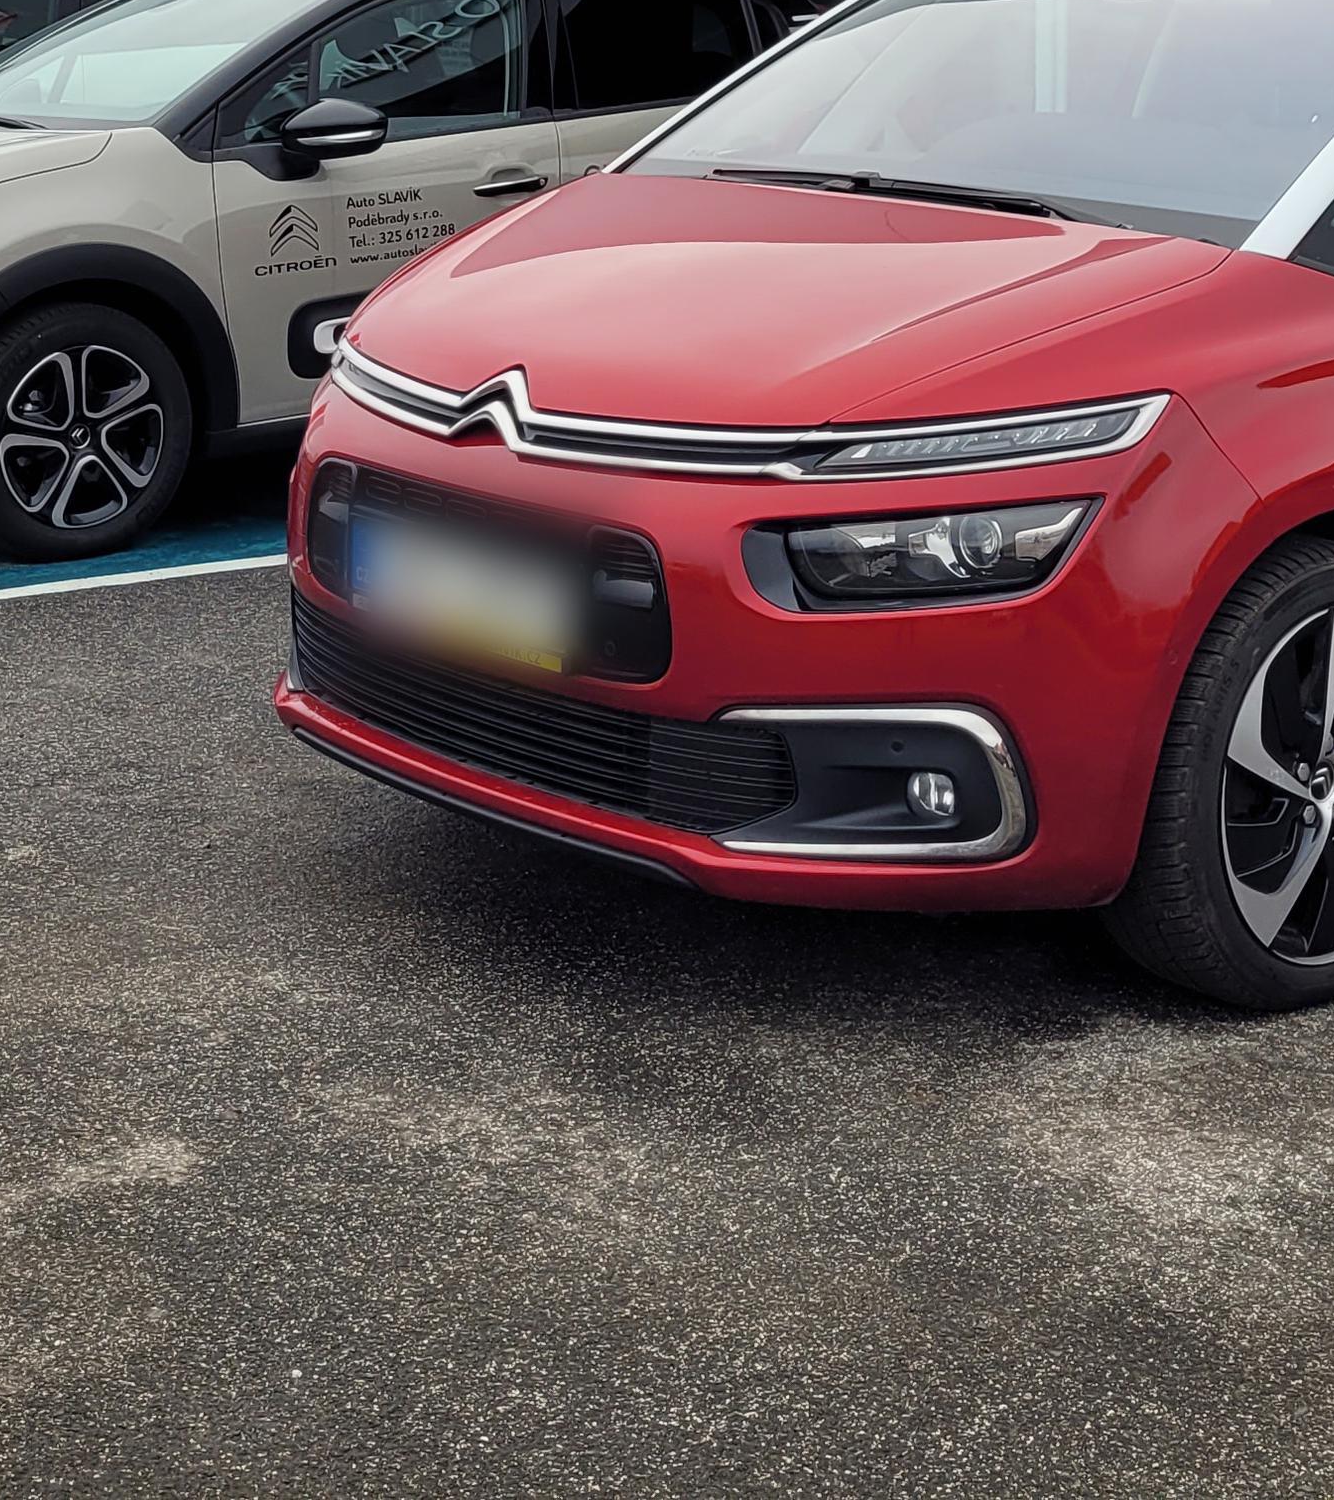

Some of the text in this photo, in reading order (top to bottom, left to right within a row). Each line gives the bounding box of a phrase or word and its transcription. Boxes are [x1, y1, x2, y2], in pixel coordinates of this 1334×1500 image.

[346, 186, 423, 209] Auto SLAVÍK
[348, 208, 443, 229] Poděbrady s.r.o.
[349, 223, 455, 248] Tel.: 325 612 288
[254, 256, 337, 276] CITROËN
